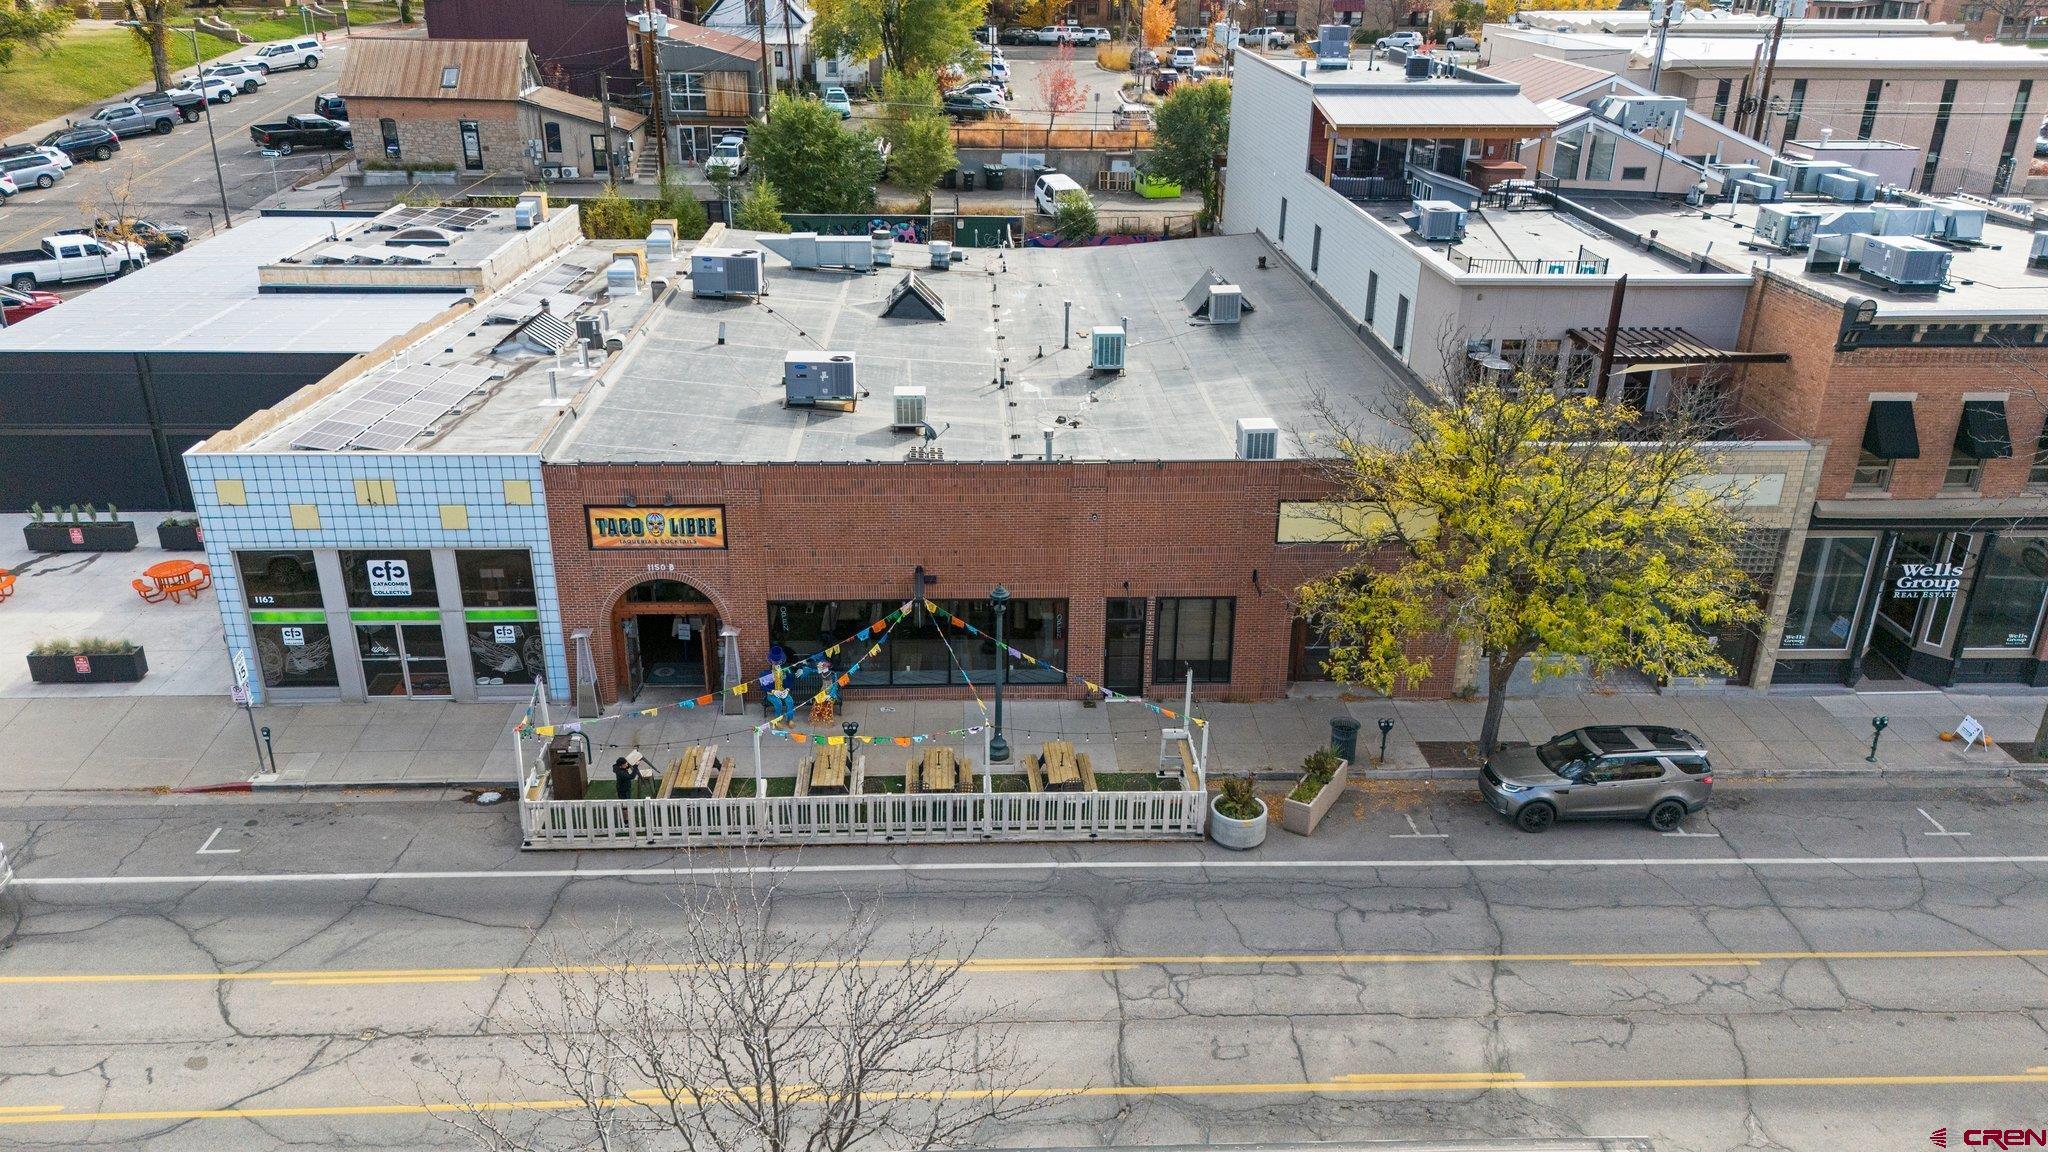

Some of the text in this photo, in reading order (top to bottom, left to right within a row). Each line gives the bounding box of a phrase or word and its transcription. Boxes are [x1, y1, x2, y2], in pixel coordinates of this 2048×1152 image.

[595, 517, 717, 537] TACO LIBRE
[669, 563, 675, 571] B
[1902, 562, 1964, 577] Wells
[1896, 576, 1960, 592] Group
[255, 596, 275, 604] 1162
[1892, 591, 1958, 599] REAL ESTATE
